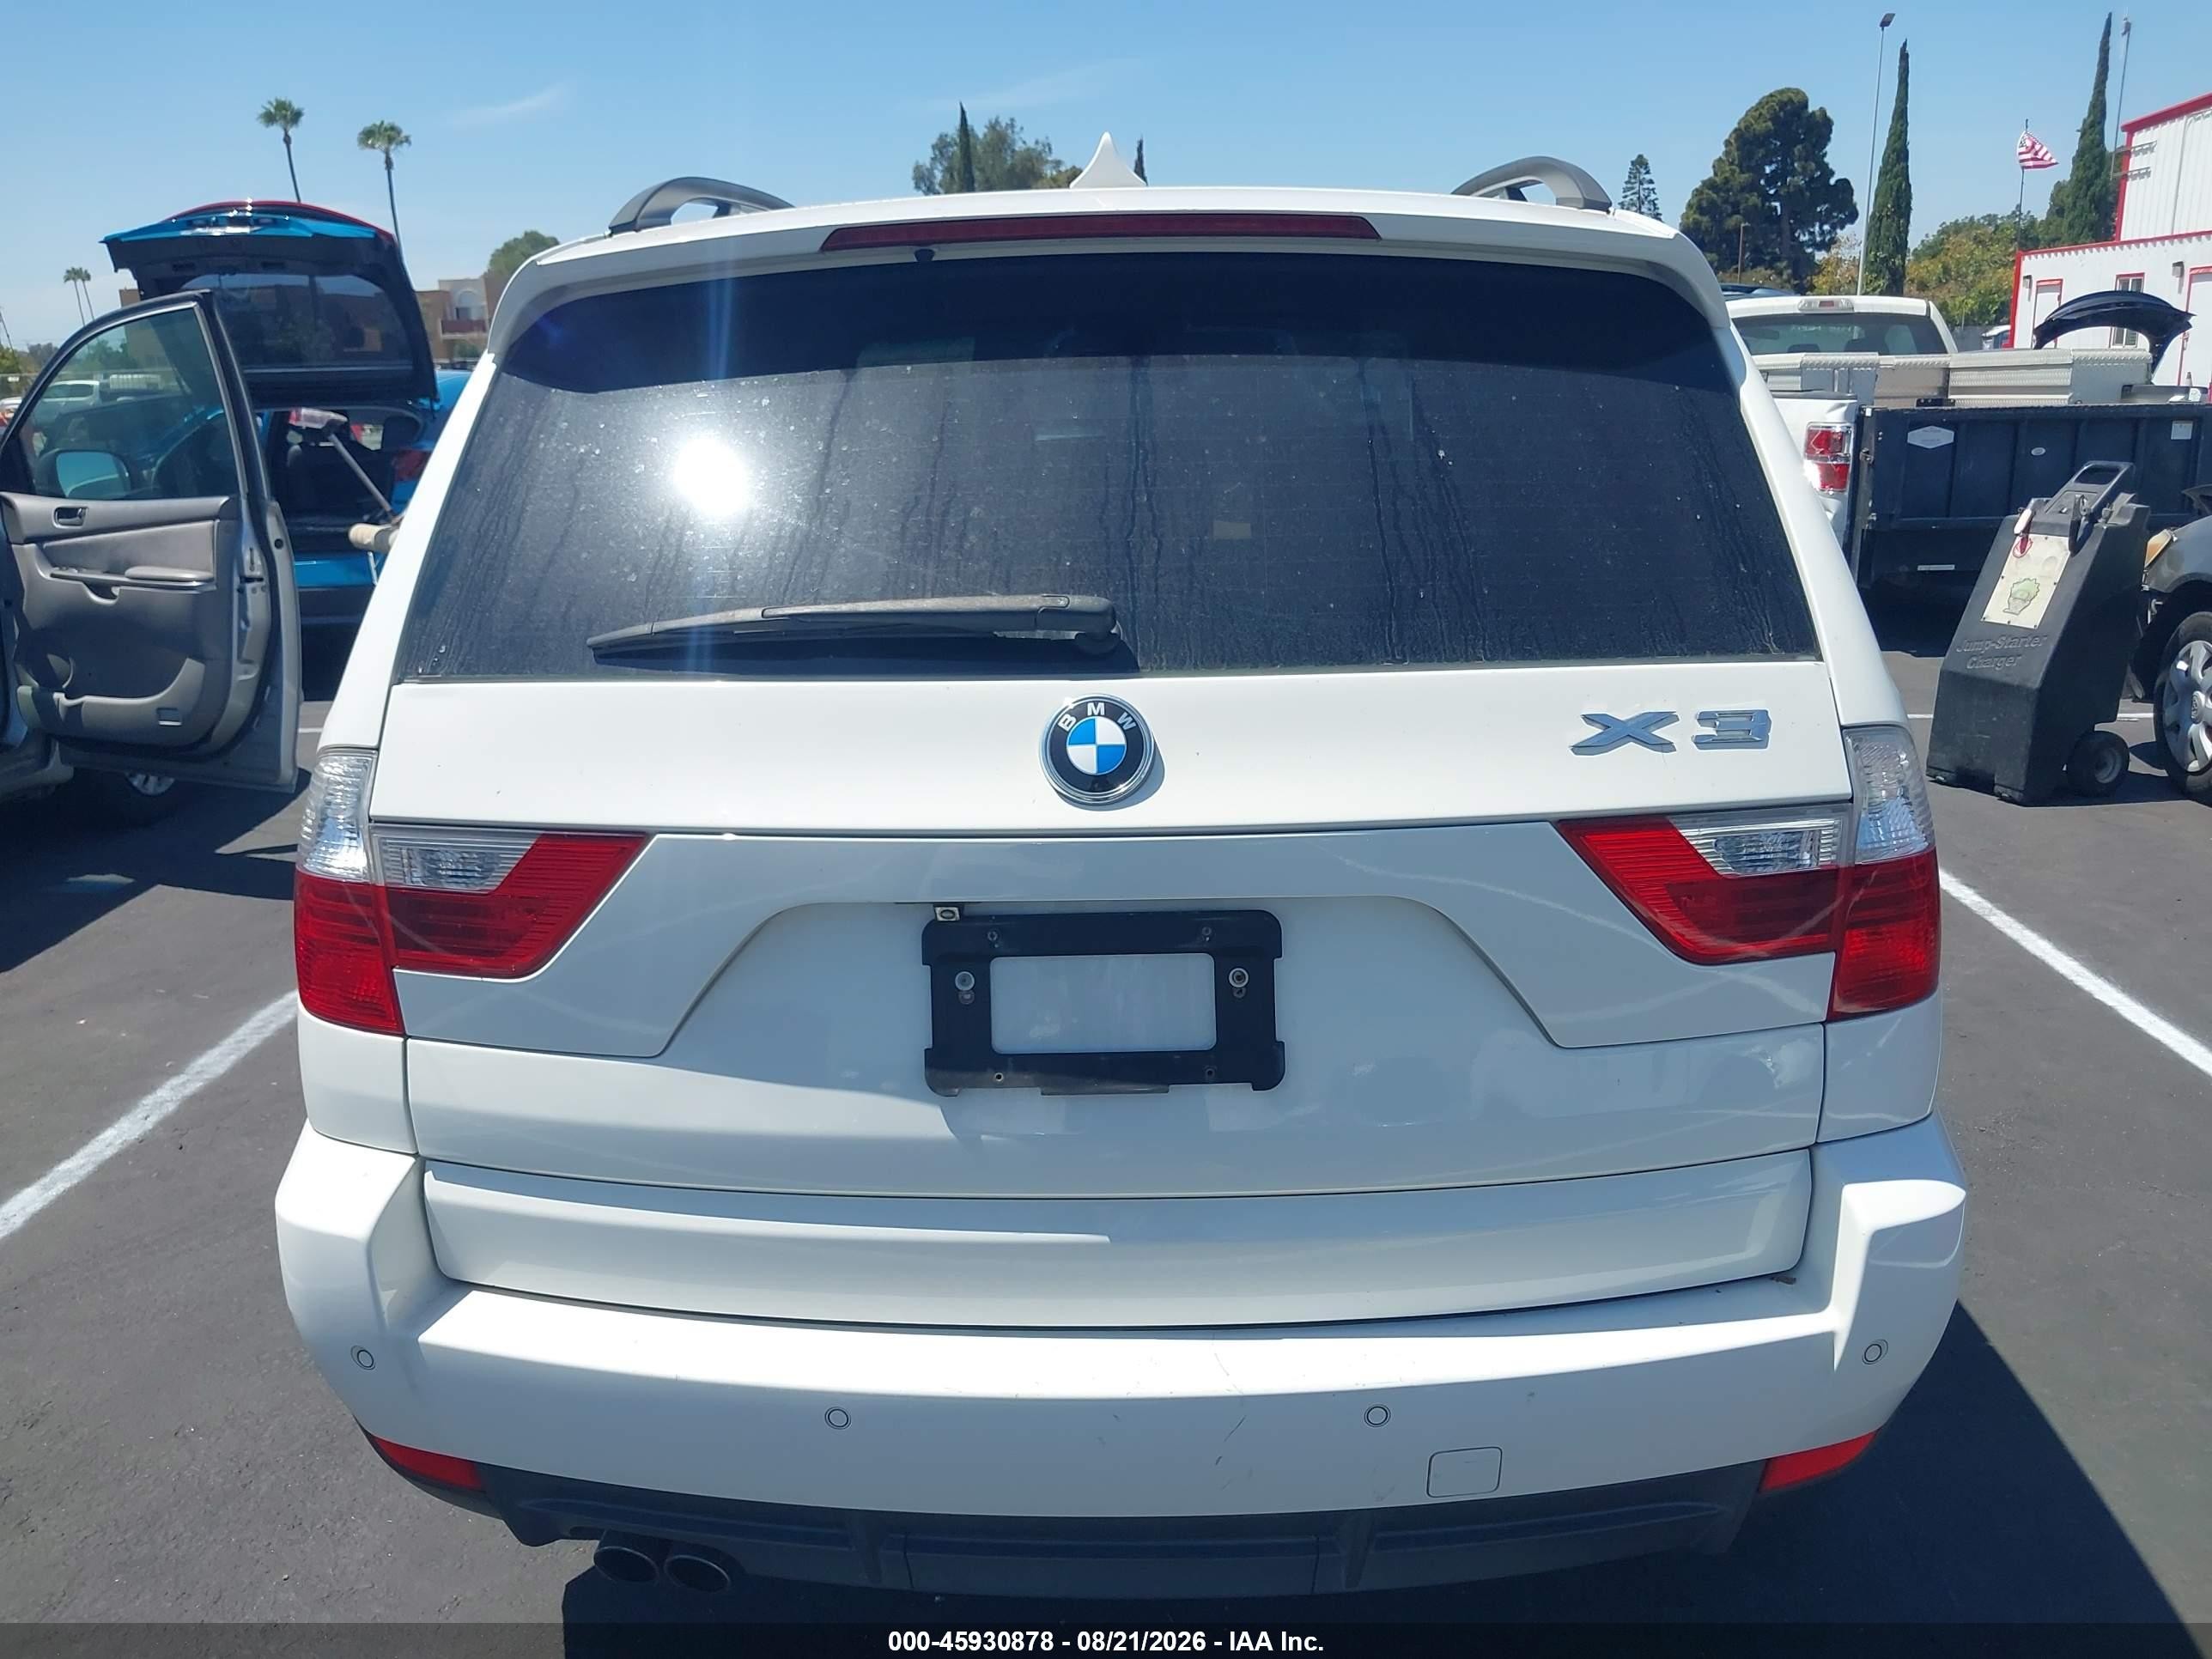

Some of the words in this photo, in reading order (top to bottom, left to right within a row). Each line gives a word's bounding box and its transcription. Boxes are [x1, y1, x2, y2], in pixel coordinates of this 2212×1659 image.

[1956, 635, 2048, 653] Jump-Starter
[1966, 653, 2022, 670] Charger
[1057, 702, 1137, 732] BMW
[1570, 709, 1771, 753] X3
